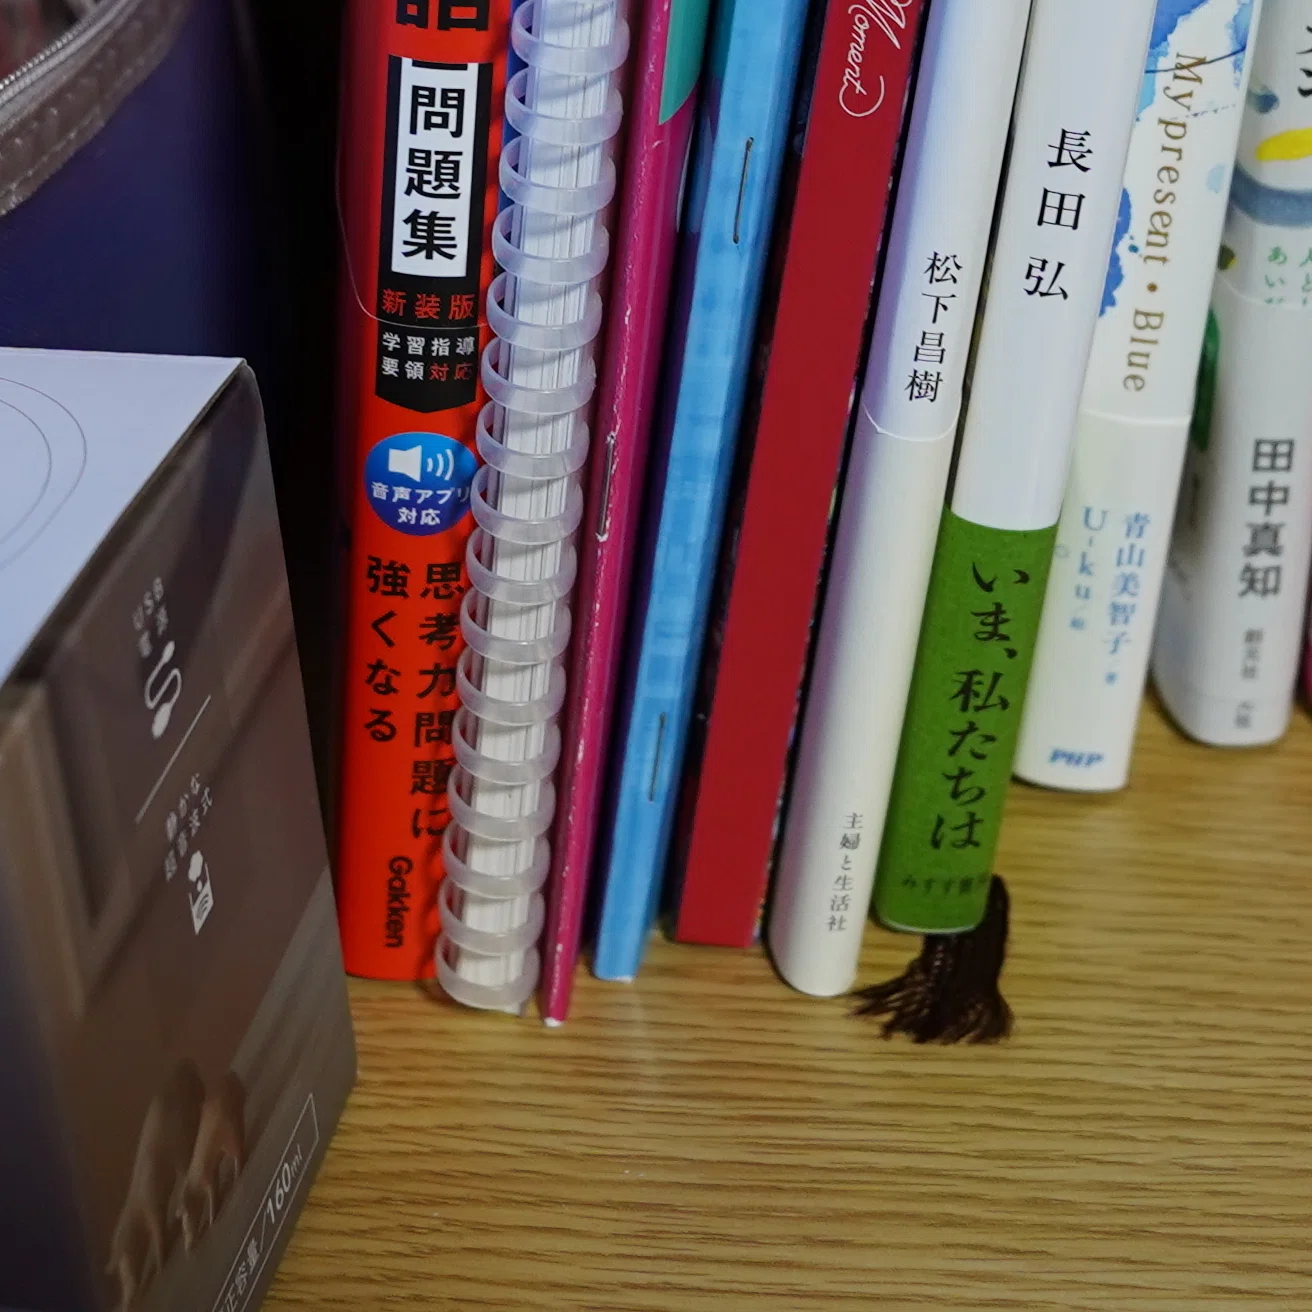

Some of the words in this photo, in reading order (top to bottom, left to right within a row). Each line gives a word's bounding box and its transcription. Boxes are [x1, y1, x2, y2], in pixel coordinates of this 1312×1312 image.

[1163, 51, 1208, 112] My
[401, 84, 466, 262] 問題集
[1021, 127, 1093, 302] 長田弘
[1143, 118, 1189, 268] present
[380, 331, 476, 357] 学習指導
[380, 356, 474, 382] 要領対応
[381, 288, 477, 320] 新装版
[904, 251, 963, 404] 松下昌樹
[1122, 308, 1166, 393] Blue
[397, 505, 441, 526] 対応
[1238, 438, 1295, 599] 田中真知
[363, 554, 411, 744] 強くなる
[410, 561, 466, 840] 思考力問題に
[930, 560, 1030, 851] いま、私たちは
[826, 811, 865, 933] 主婦と生活社
